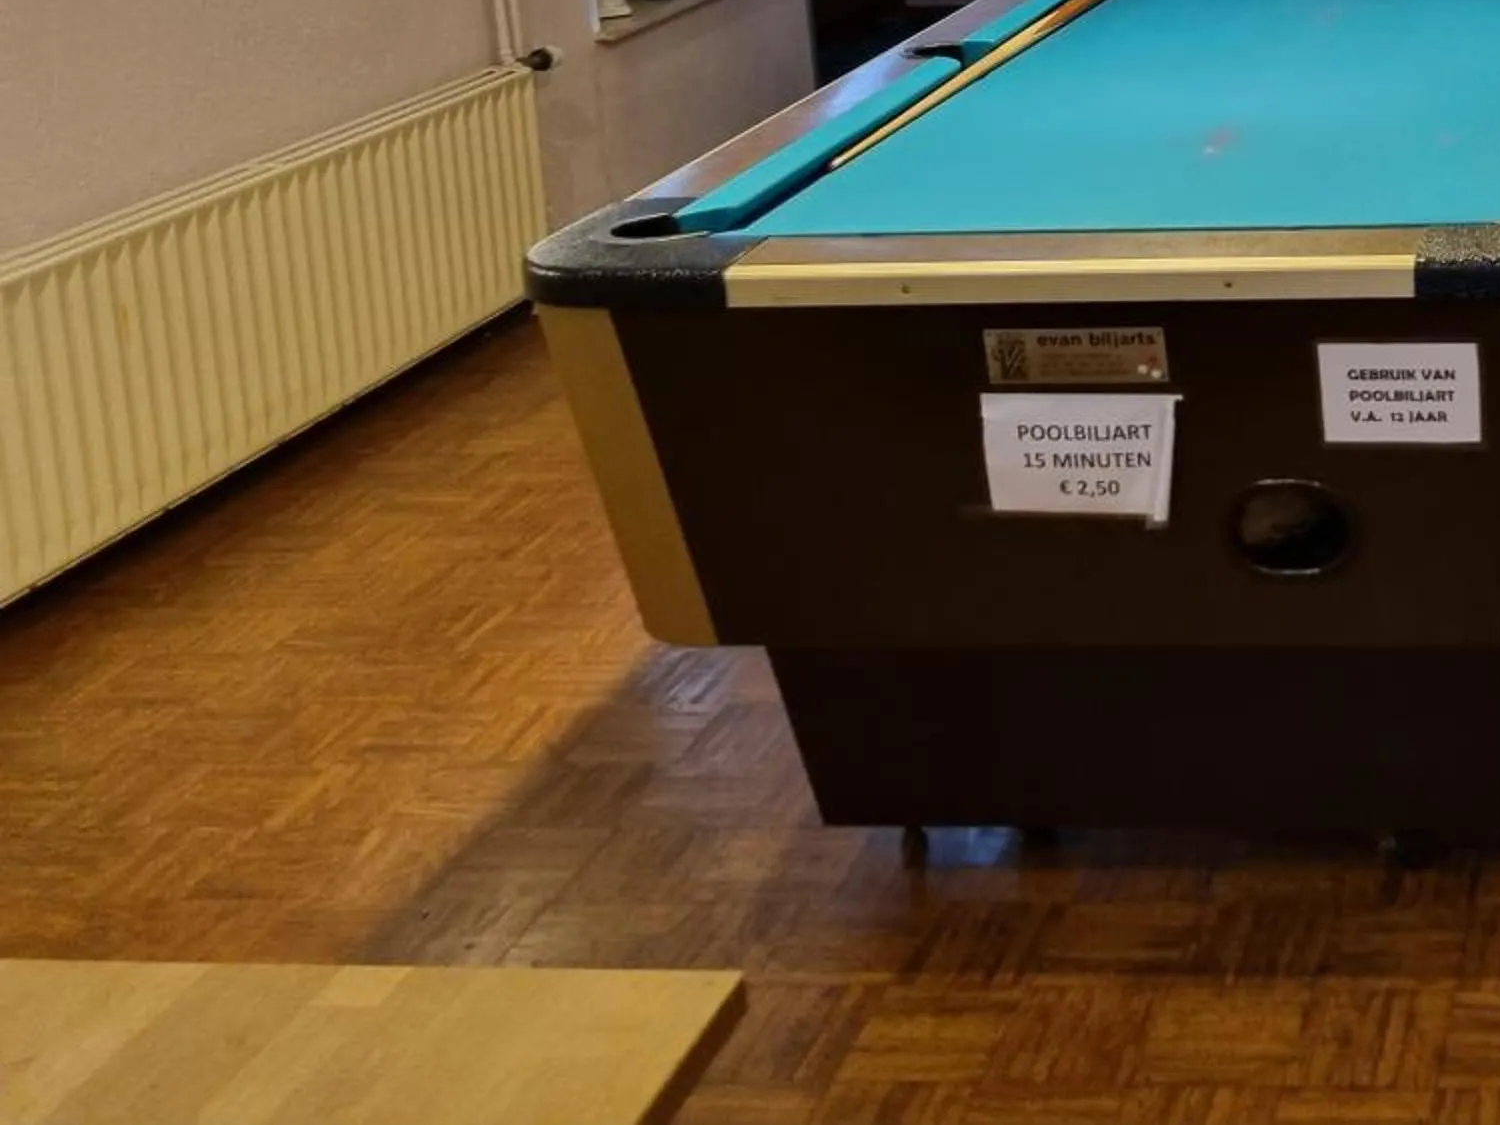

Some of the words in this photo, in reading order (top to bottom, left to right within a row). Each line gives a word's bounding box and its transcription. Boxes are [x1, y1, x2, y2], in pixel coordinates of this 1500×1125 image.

[1088, 331, 1157, 348] biljarts
[1347, 368, 1417, 381] GEBRUIK
[1421, 368, 1457, 381] VAN
[1349, 389, 1455, 403] POOLBILJART
[1351, 410, 1383, 422] V.A.
[1409, 410, 1448, 423] JAAR
[1017, 424, 1153, 442] POOLBILJART
[1023, 452, 1046, 468] 15
[1053, 451, 1152, 469] MINUTEN
[1059, 480, 1073, 495] €
[1076, 479, 1121, 498] 2,50
